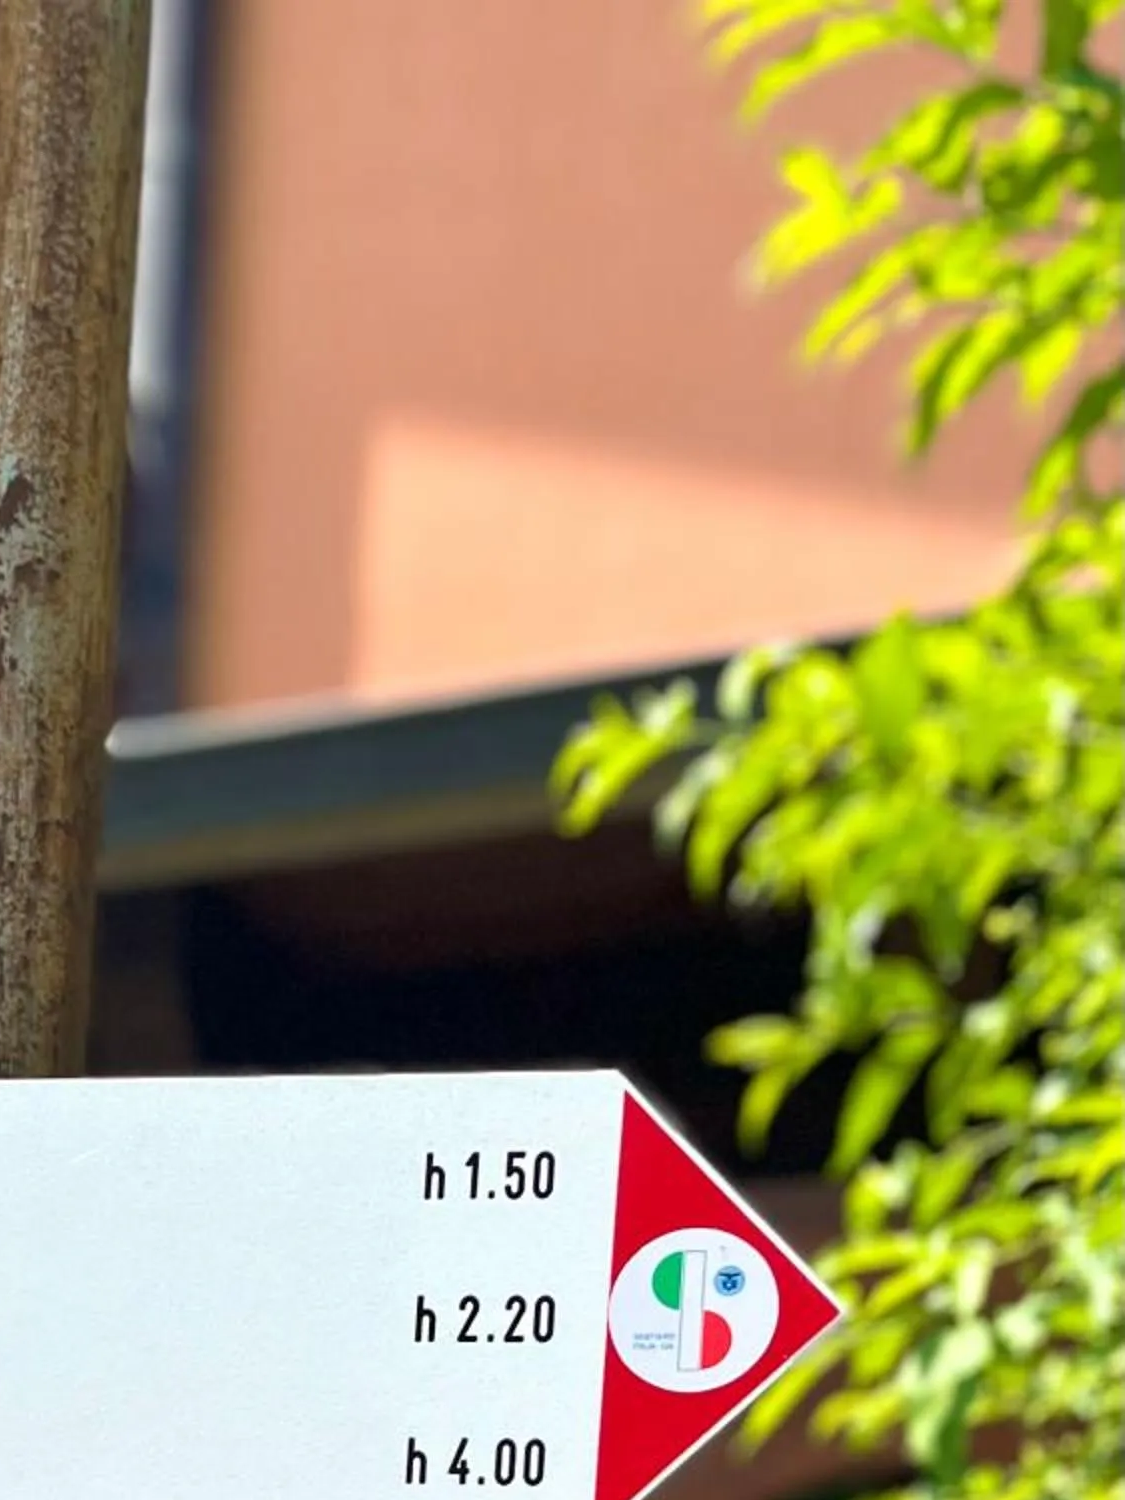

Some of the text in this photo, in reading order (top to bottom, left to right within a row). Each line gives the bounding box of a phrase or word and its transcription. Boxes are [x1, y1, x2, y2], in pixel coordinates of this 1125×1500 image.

[424, 1151, 556, 1200] h 1.50
[414, 1295, 556, 1343] h 2.20
[405, 1437, 546, 1487] h 4.00
